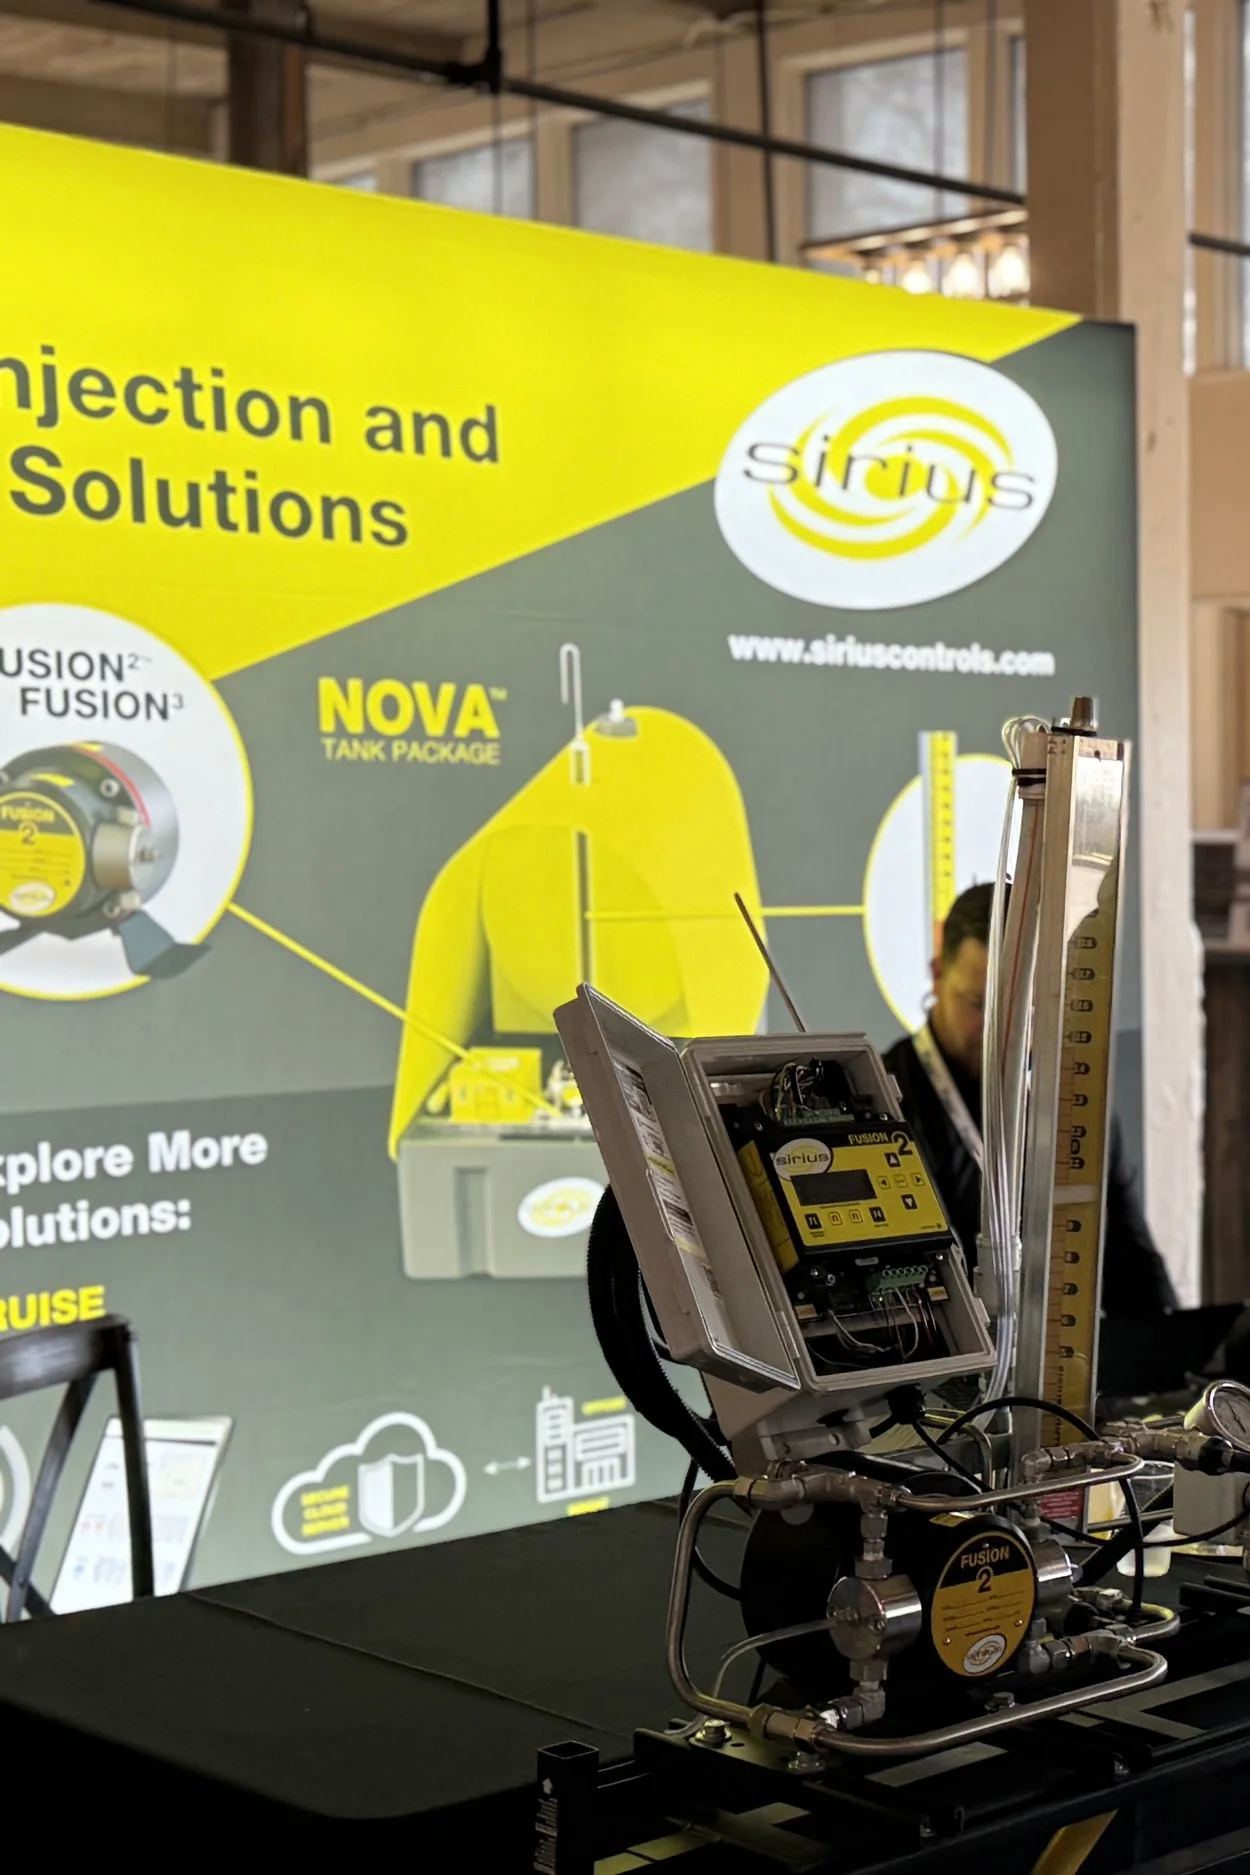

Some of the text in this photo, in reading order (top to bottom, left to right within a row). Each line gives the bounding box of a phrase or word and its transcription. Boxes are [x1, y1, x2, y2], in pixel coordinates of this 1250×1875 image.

[364, 404, 500, 464] and
[743, 434, 1038, 511] sirius
[9, 445, 409, 547] Solutions
[727, 633, 1056, 677] www.siriuscontrols.com
[320, 737, 501, 765] TANK PACKAGE
[148, 1129, 268, 1173] More
[776, 1152, 829, 1166] sirius
[848, 1131, 913, 1156] FUSION 2
[960, 1546, 1010, 1569] FUSION
[976, 1565, 994, 1594] 2
